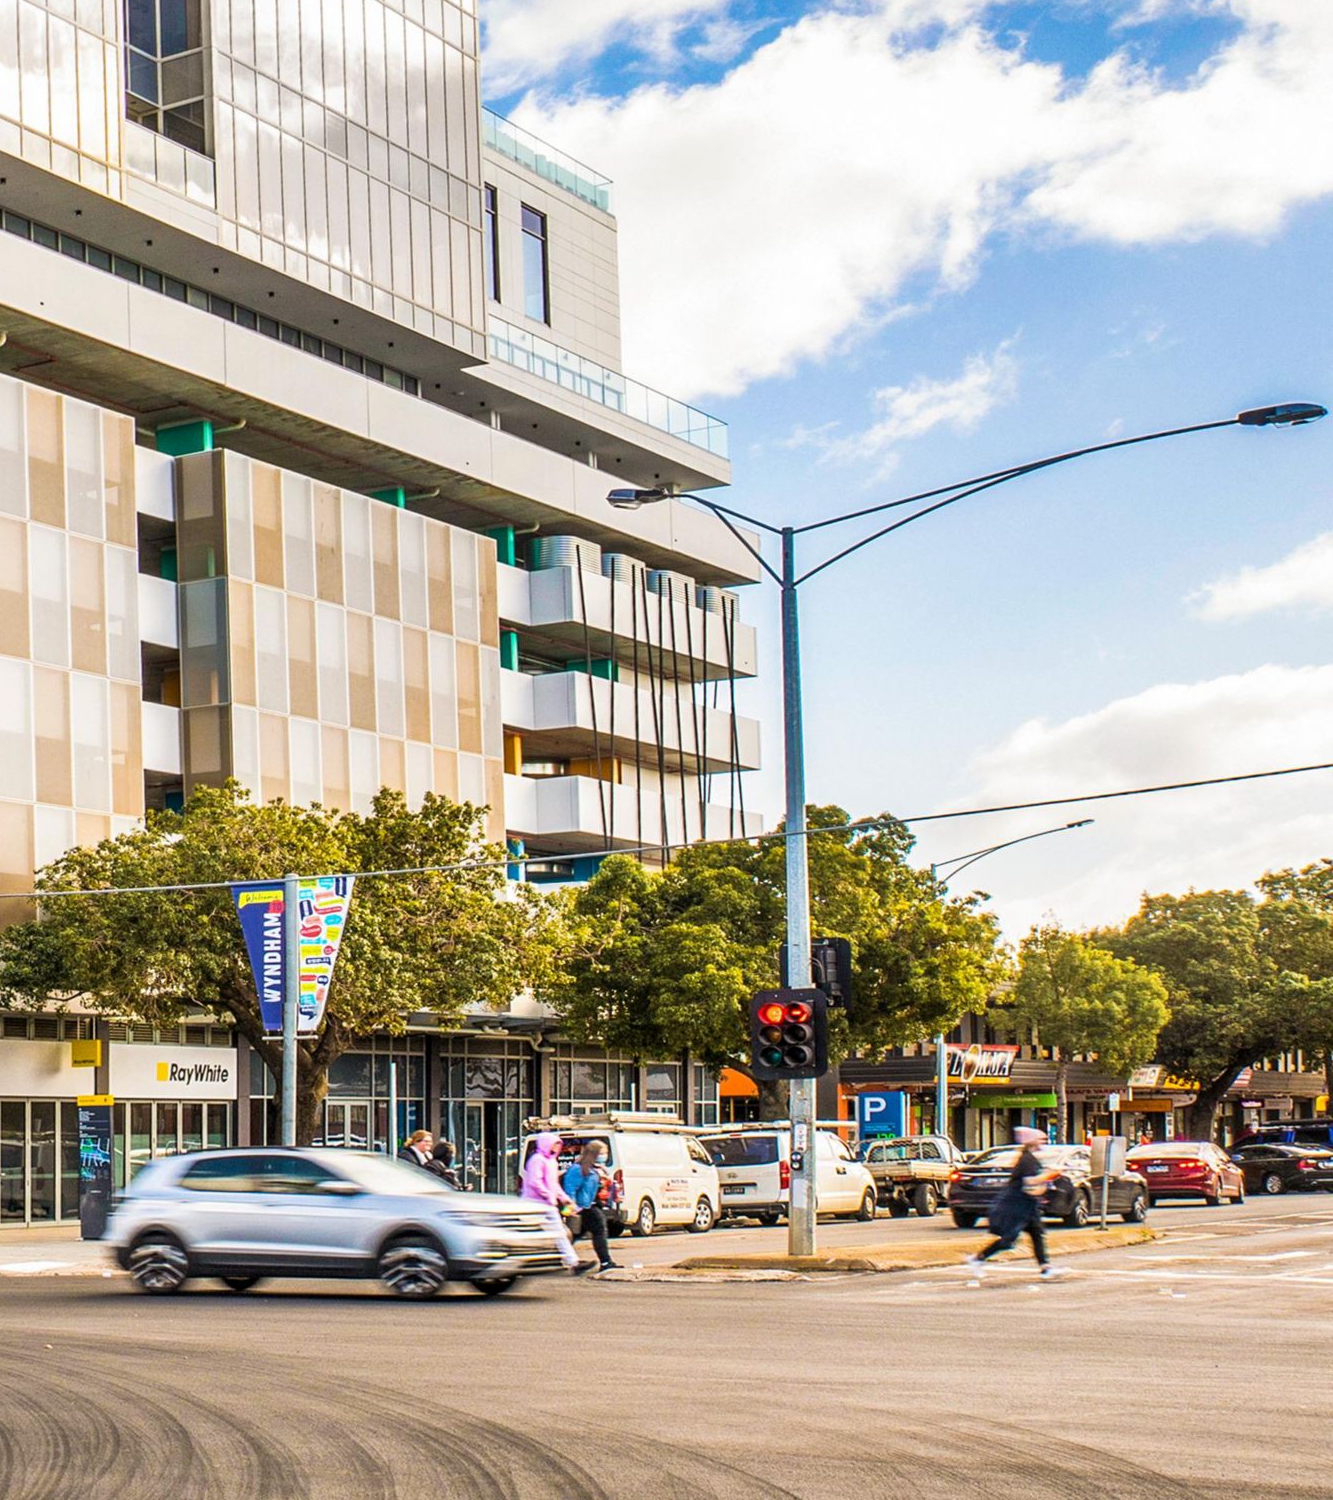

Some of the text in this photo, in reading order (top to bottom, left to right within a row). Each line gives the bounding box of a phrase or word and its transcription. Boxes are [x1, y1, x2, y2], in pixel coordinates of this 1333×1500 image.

[263, 912, 282, 1003] WYNDHAM
[169, 1062, 229, 1085] RayWhite
[864, 1097, 887, 1121] P
